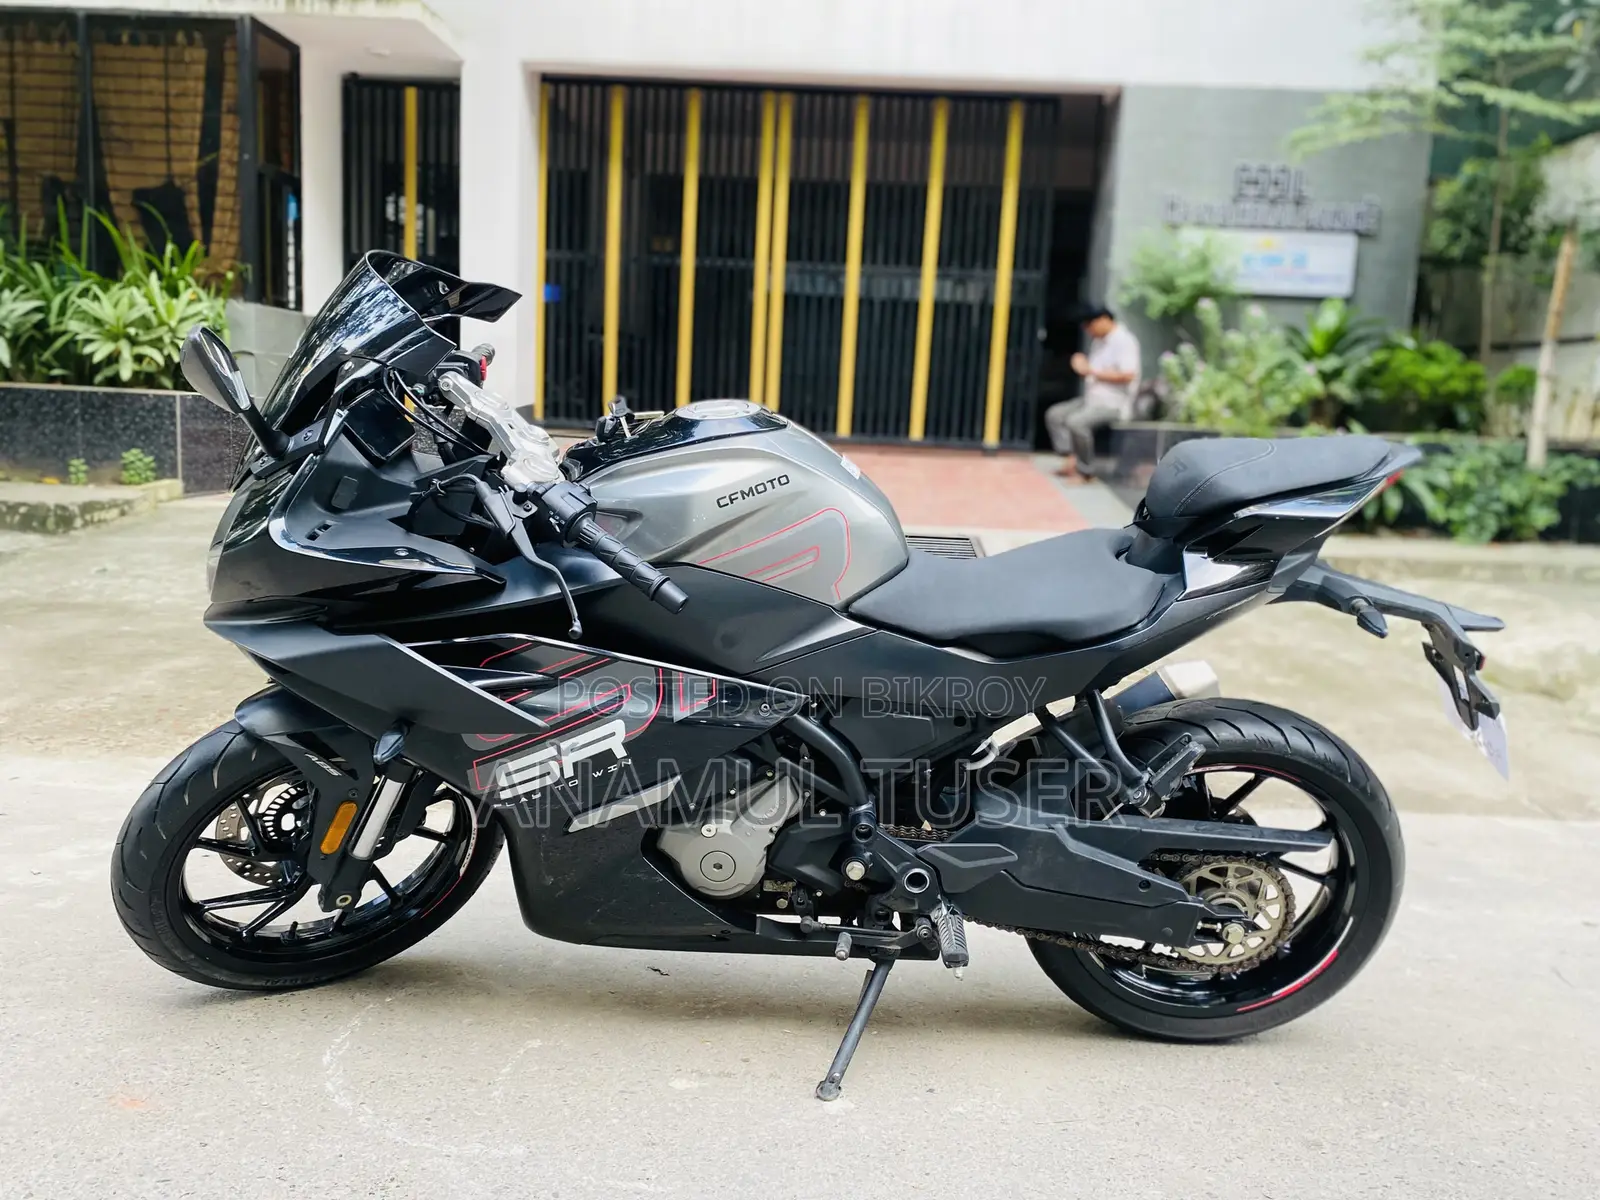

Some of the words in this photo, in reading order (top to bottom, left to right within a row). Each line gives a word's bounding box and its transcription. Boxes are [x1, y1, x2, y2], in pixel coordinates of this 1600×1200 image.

[716, 474, 790, 508] CFMOTO
[495, 719, 628, 800] SR
[555, 779, 579, 791] TO
[592, 758, 632, 778] WIN
